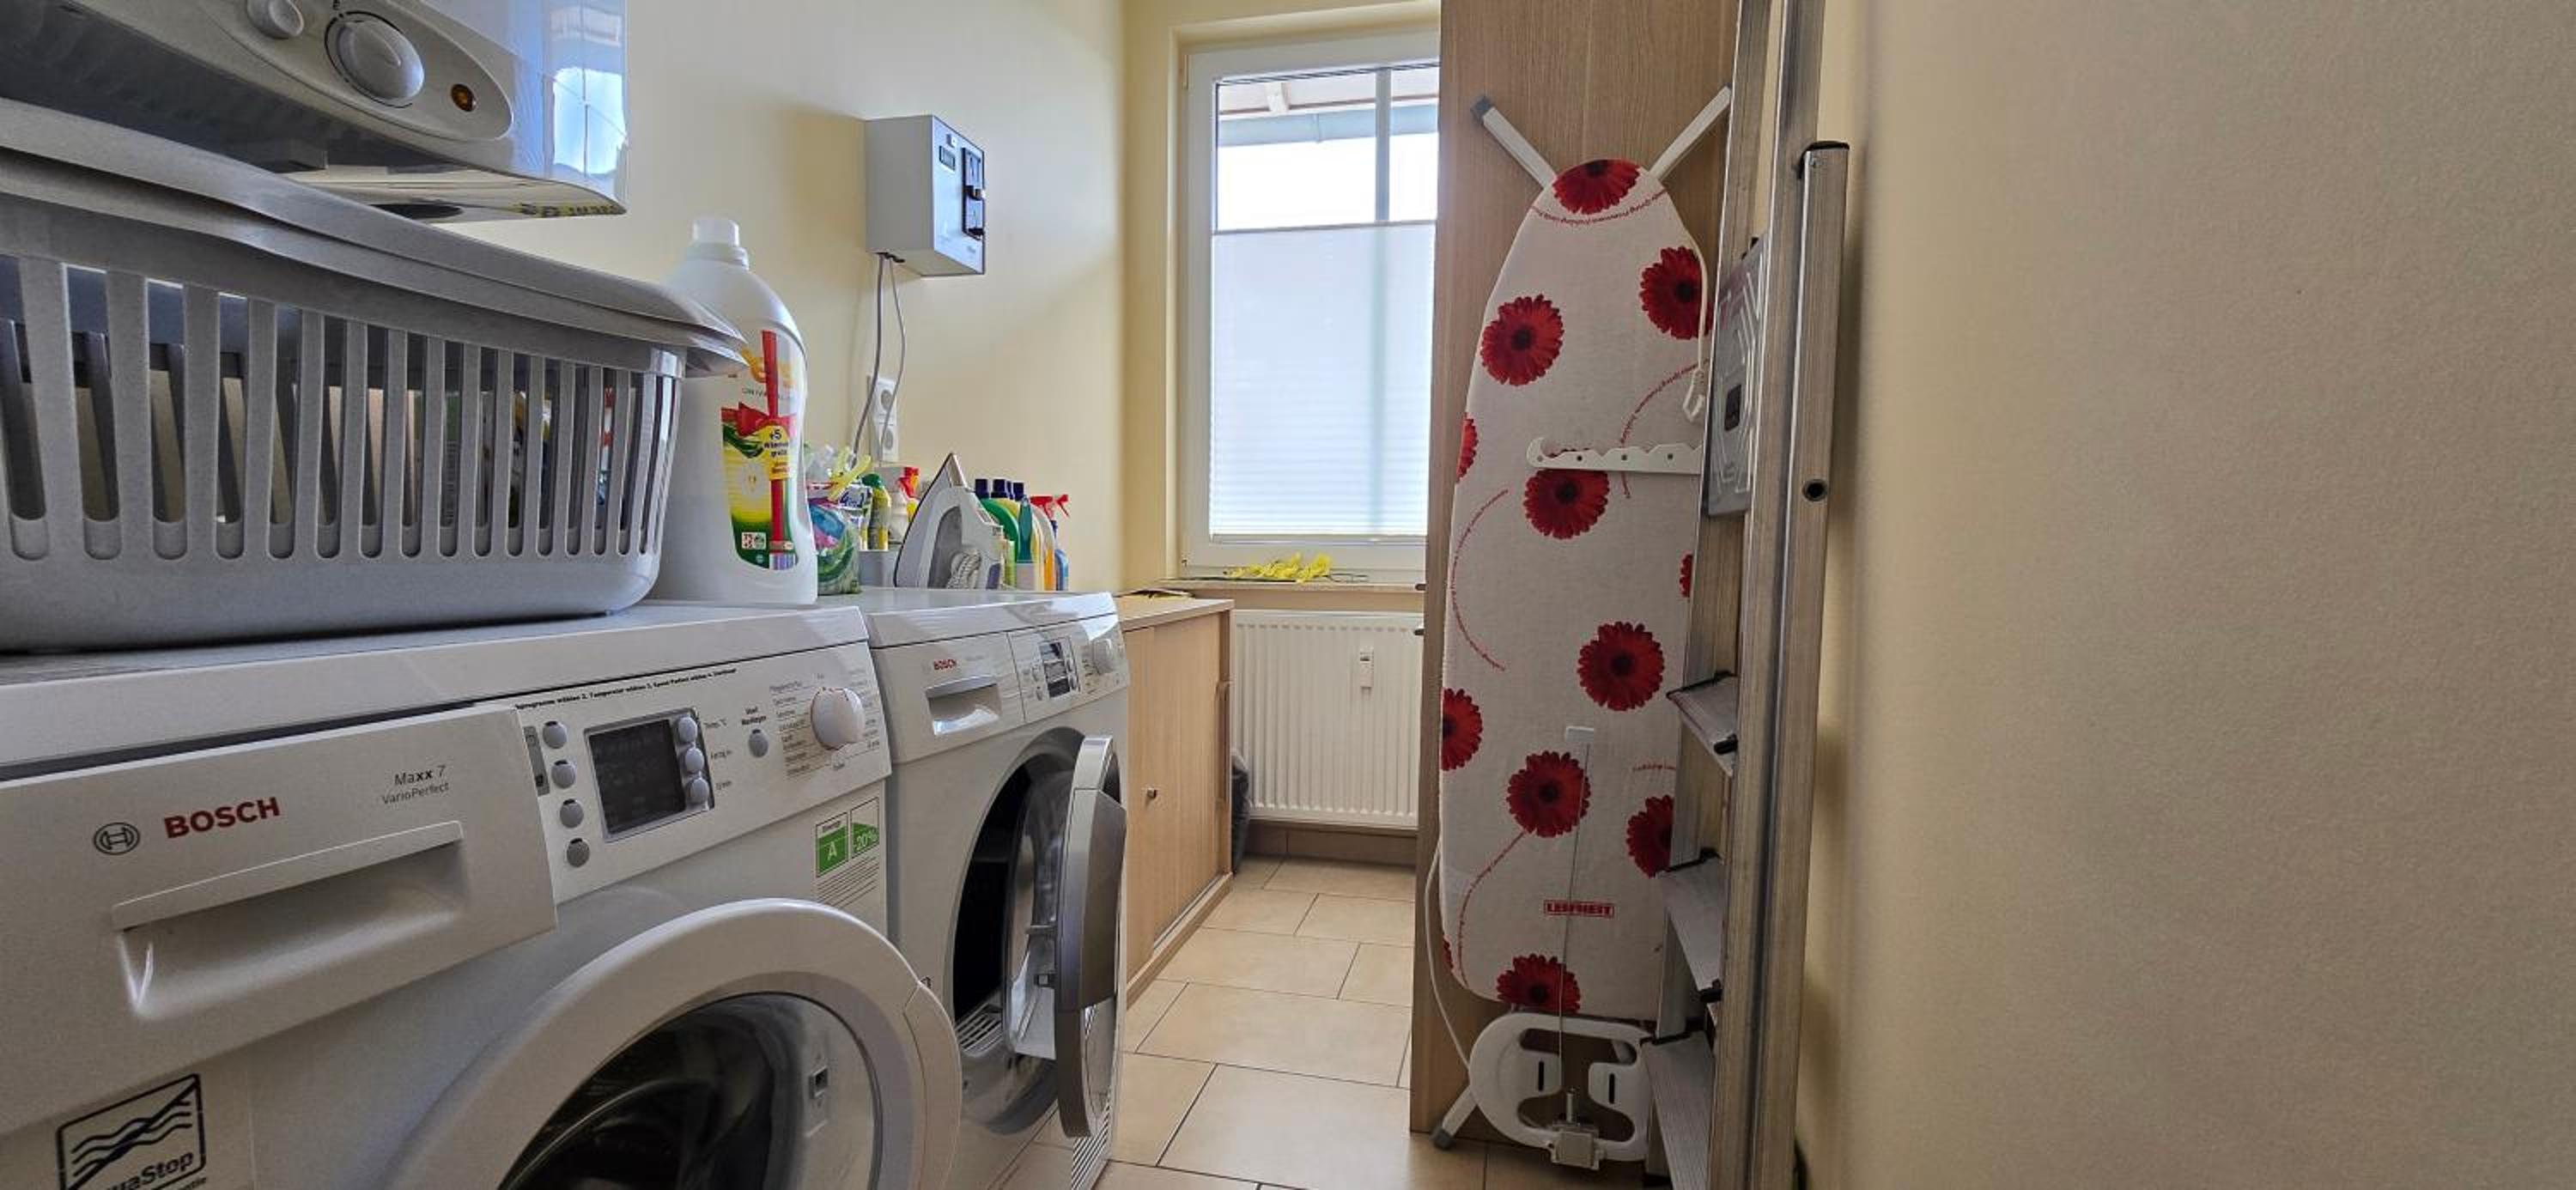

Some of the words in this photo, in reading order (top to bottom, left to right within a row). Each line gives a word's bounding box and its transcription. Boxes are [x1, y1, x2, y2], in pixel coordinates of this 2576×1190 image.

[394, 769, 434, 786] Maxx
[436, 764, 446, 778] 7
[381, 782, 450, 804] VarioPerfect
[164, 797, 281, 838] BOSCH
[827, 841, 838, 861] A
